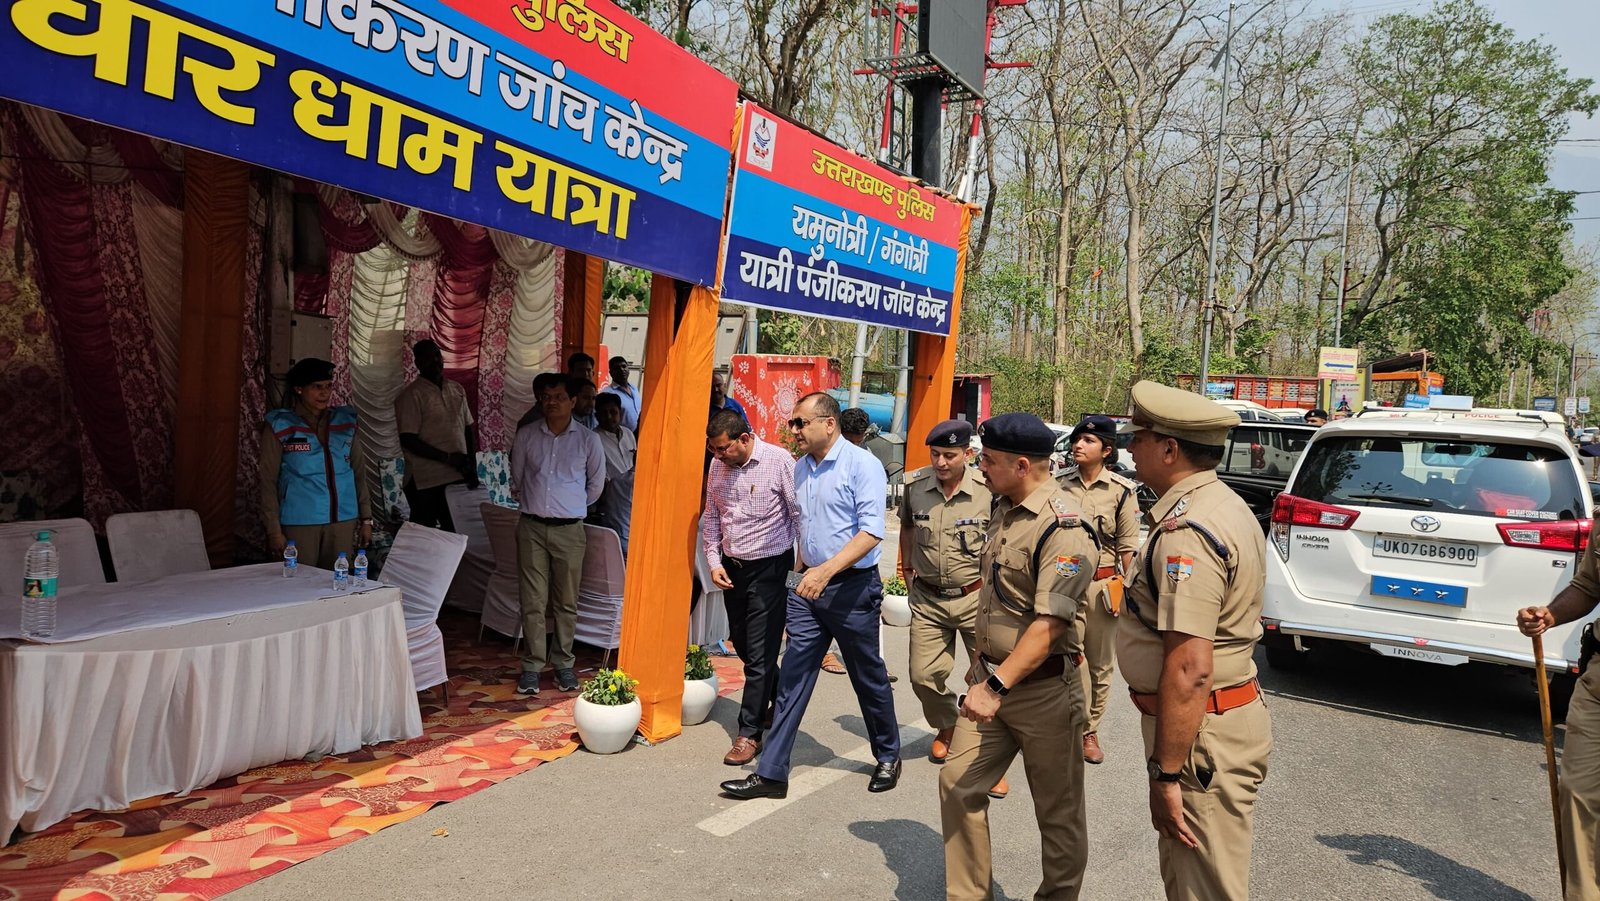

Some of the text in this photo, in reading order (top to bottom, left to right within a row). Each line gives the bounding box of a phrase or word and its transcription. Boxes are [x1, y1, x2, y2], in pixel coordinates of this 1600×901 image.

[288, 69, 484, 193] धाम
[494, 138, 637, 240] यात्रा
[495, 50, 600, 144] जांच
[603, 98, 688, 186] केन्द्र
[811, 149, 936, 222] उत्तराखण्ड पुलिस
[791, 204, 869, 261] यमुनोत्री
[880, 231, 929, 275] गंगोत्री
[739, 247, 948, 328] यात्री पंजीकरण जांच केन्द्र
[1383, 540, 1476, 561] UK07GB6900
[1393, 648, 1443, 661] INNOVA
